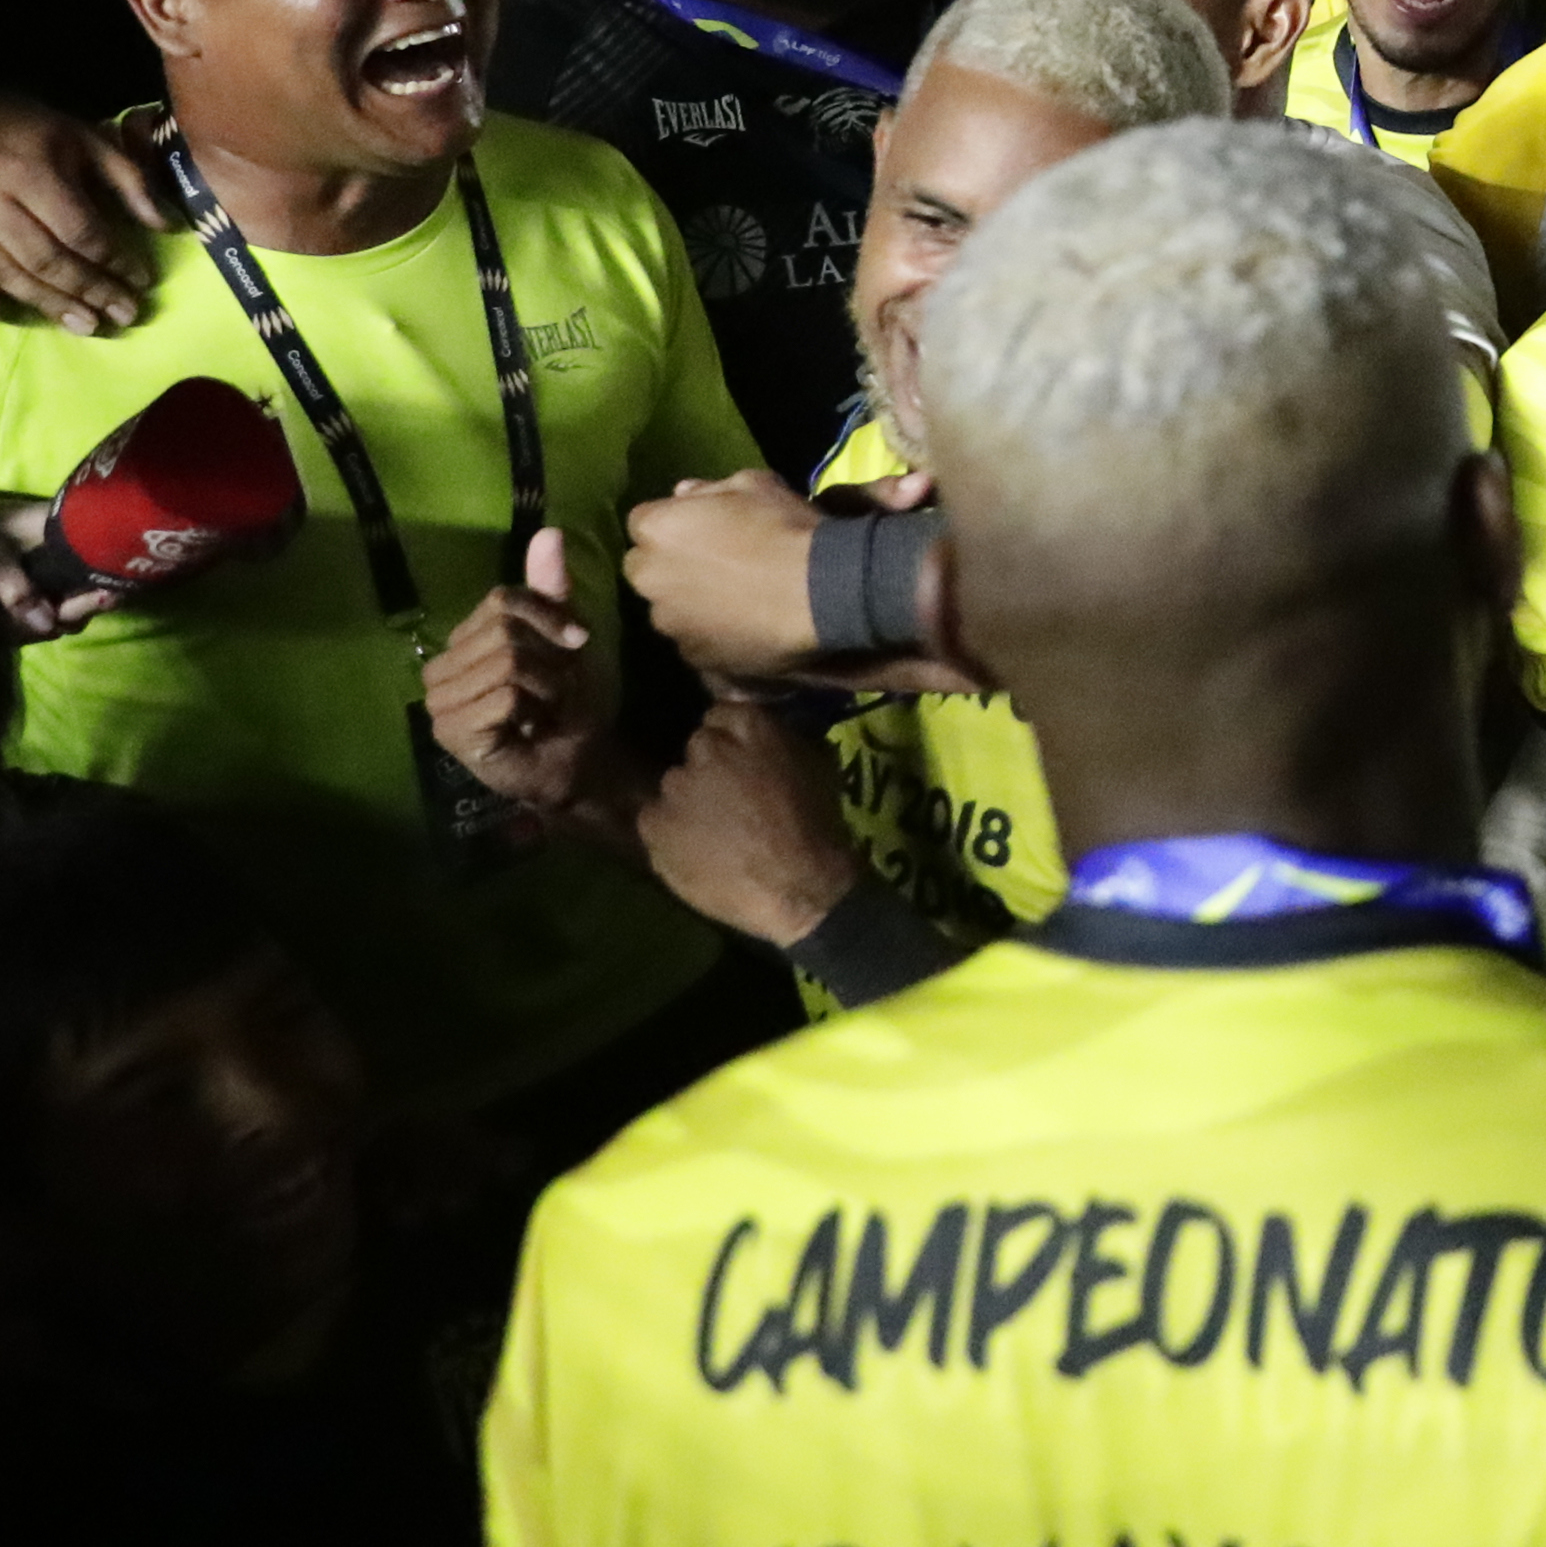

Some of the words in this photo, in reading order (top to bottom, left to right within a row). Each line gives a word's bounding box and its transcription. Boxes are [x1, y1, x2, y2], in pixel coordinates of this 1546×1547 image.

[652, 93, 746, 141] EVERLAST
[224, 247, 263, 299] Concacaf
[523, 306, 603, 361] VERLAST
